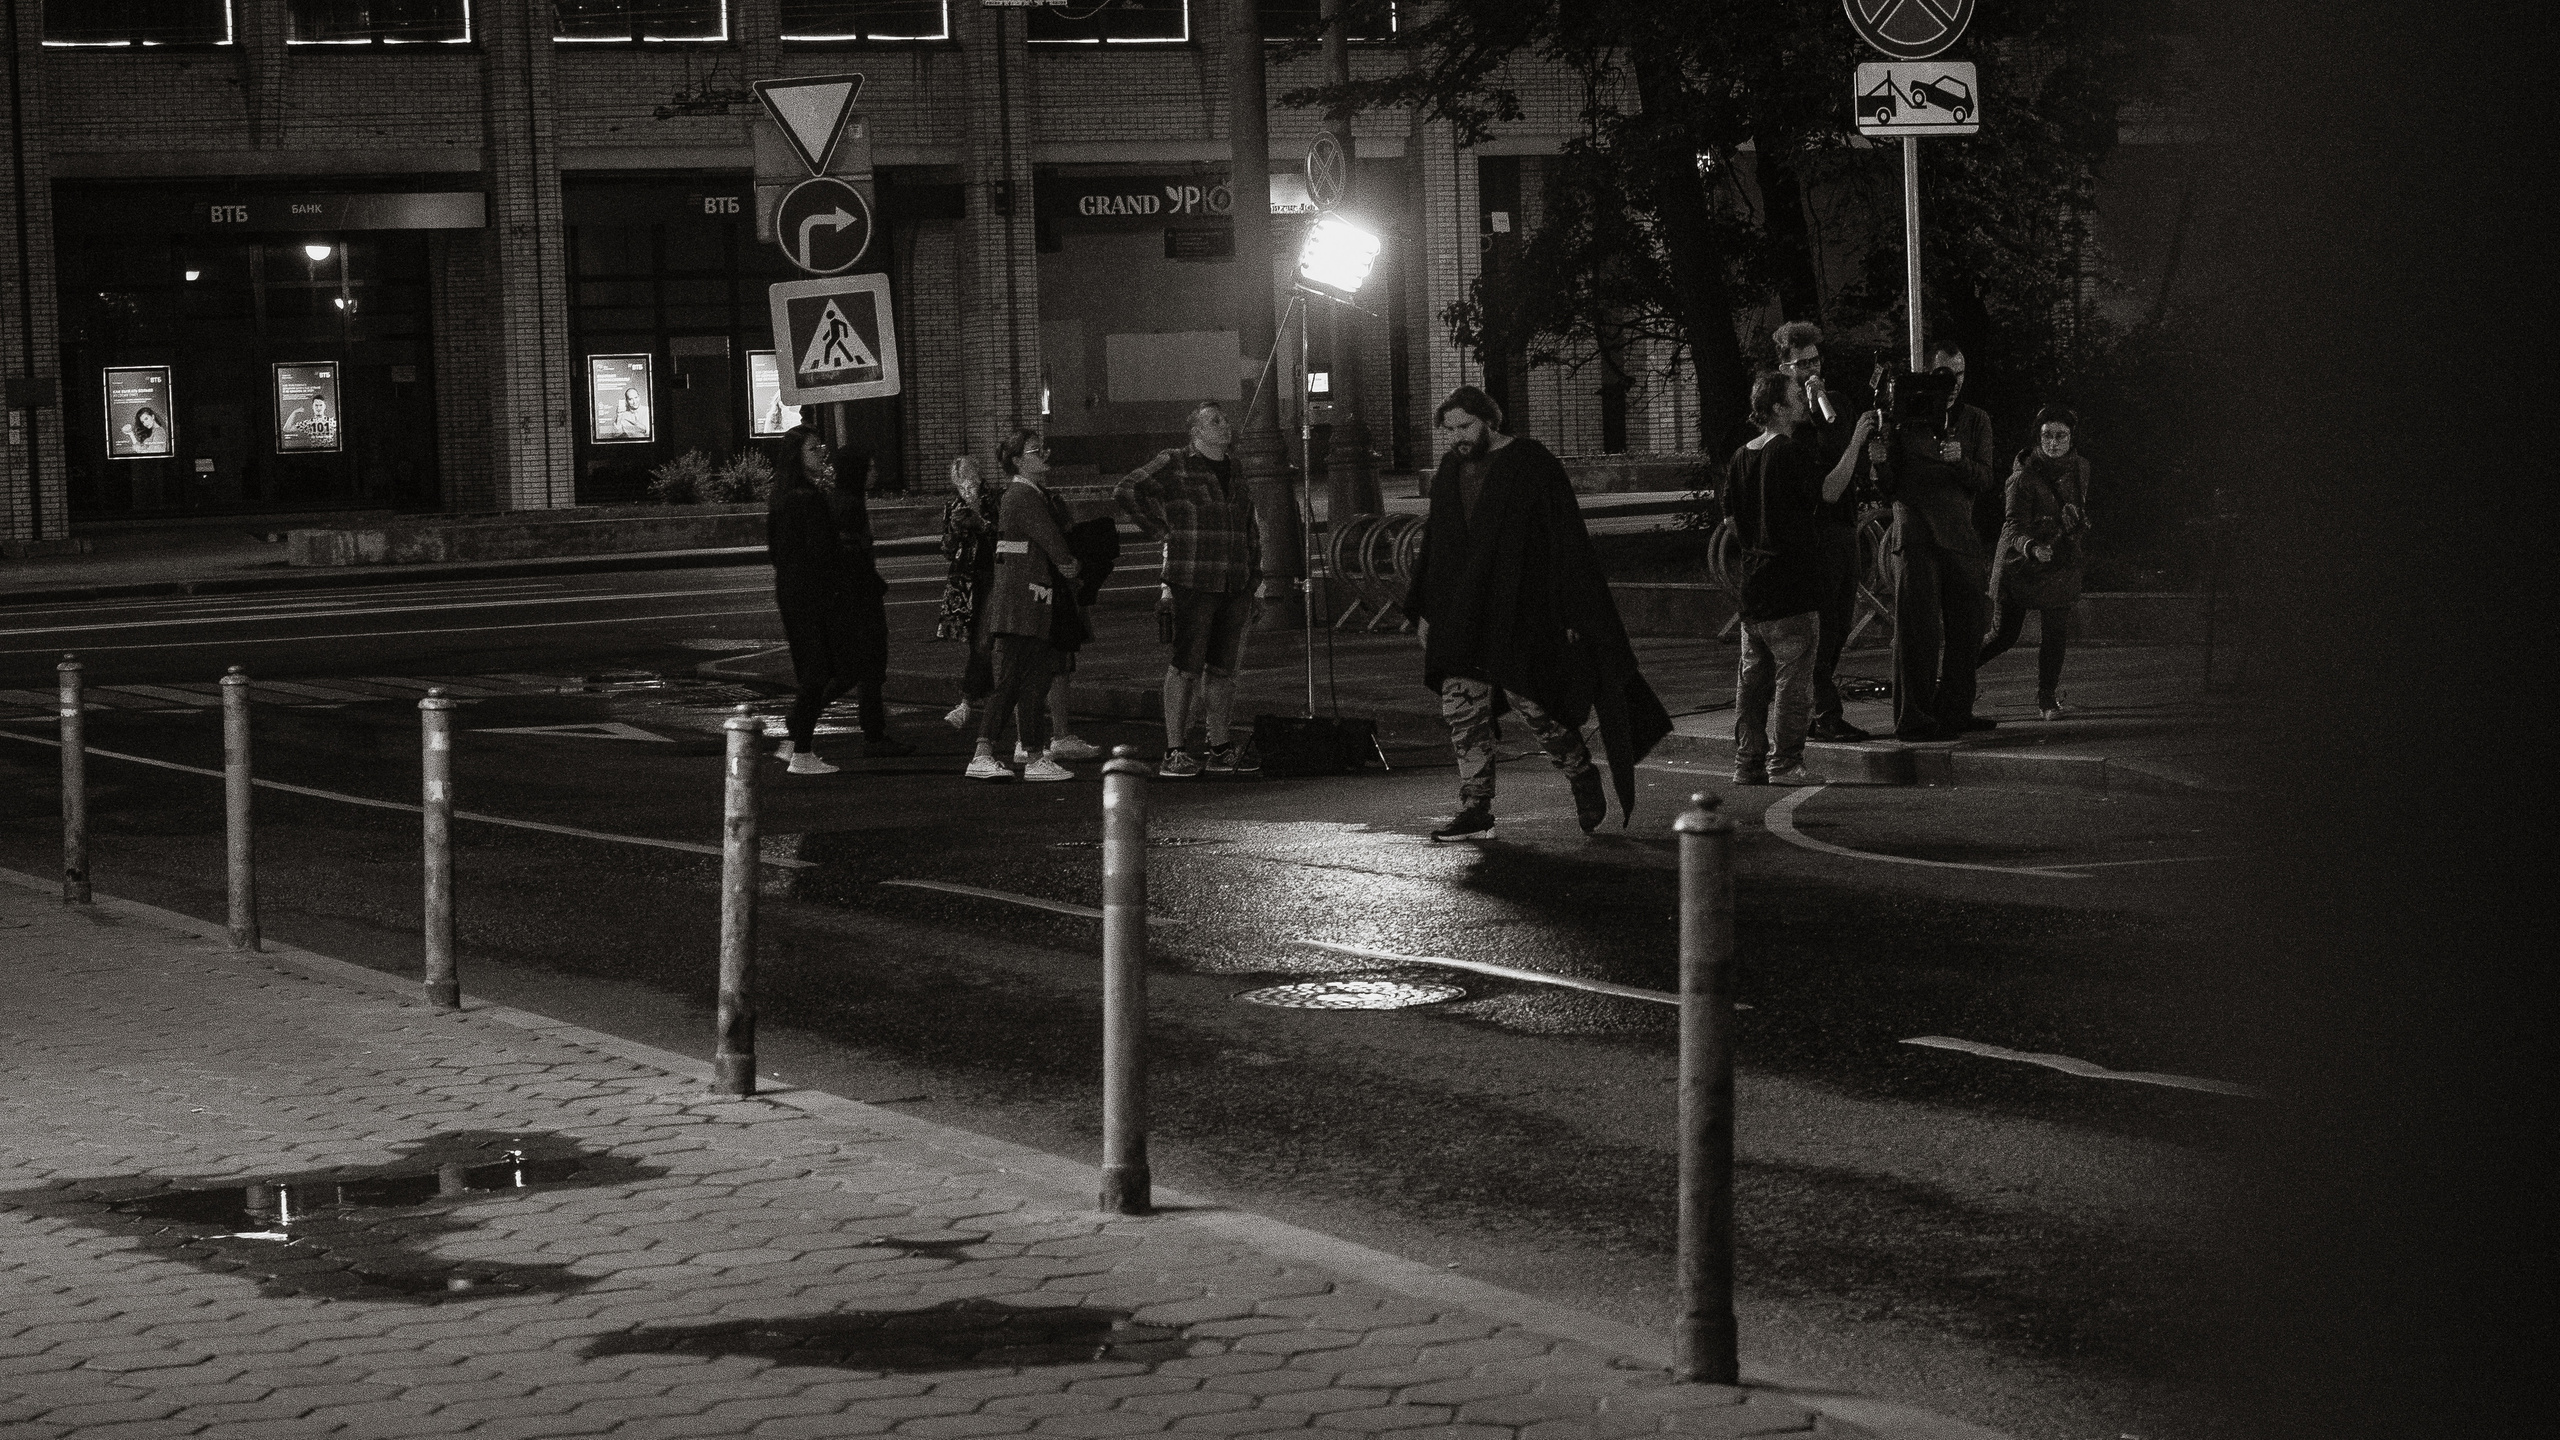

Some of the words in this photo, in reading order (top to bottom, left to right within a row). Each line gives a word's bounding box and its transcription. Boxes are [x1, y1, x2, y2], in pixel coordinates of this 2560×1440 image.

[705, 197, 740, 214] ВТБ
[1079, 195, 1160, 215] GRAND
[211, 205, 248, 222] ВТБ
[292, 204, 322, 214] БАНК
[150, 376, 162, 384] ВТБ
[319, 371, 331, 379] ВТБ
[311, 422, 329, 433] 101
